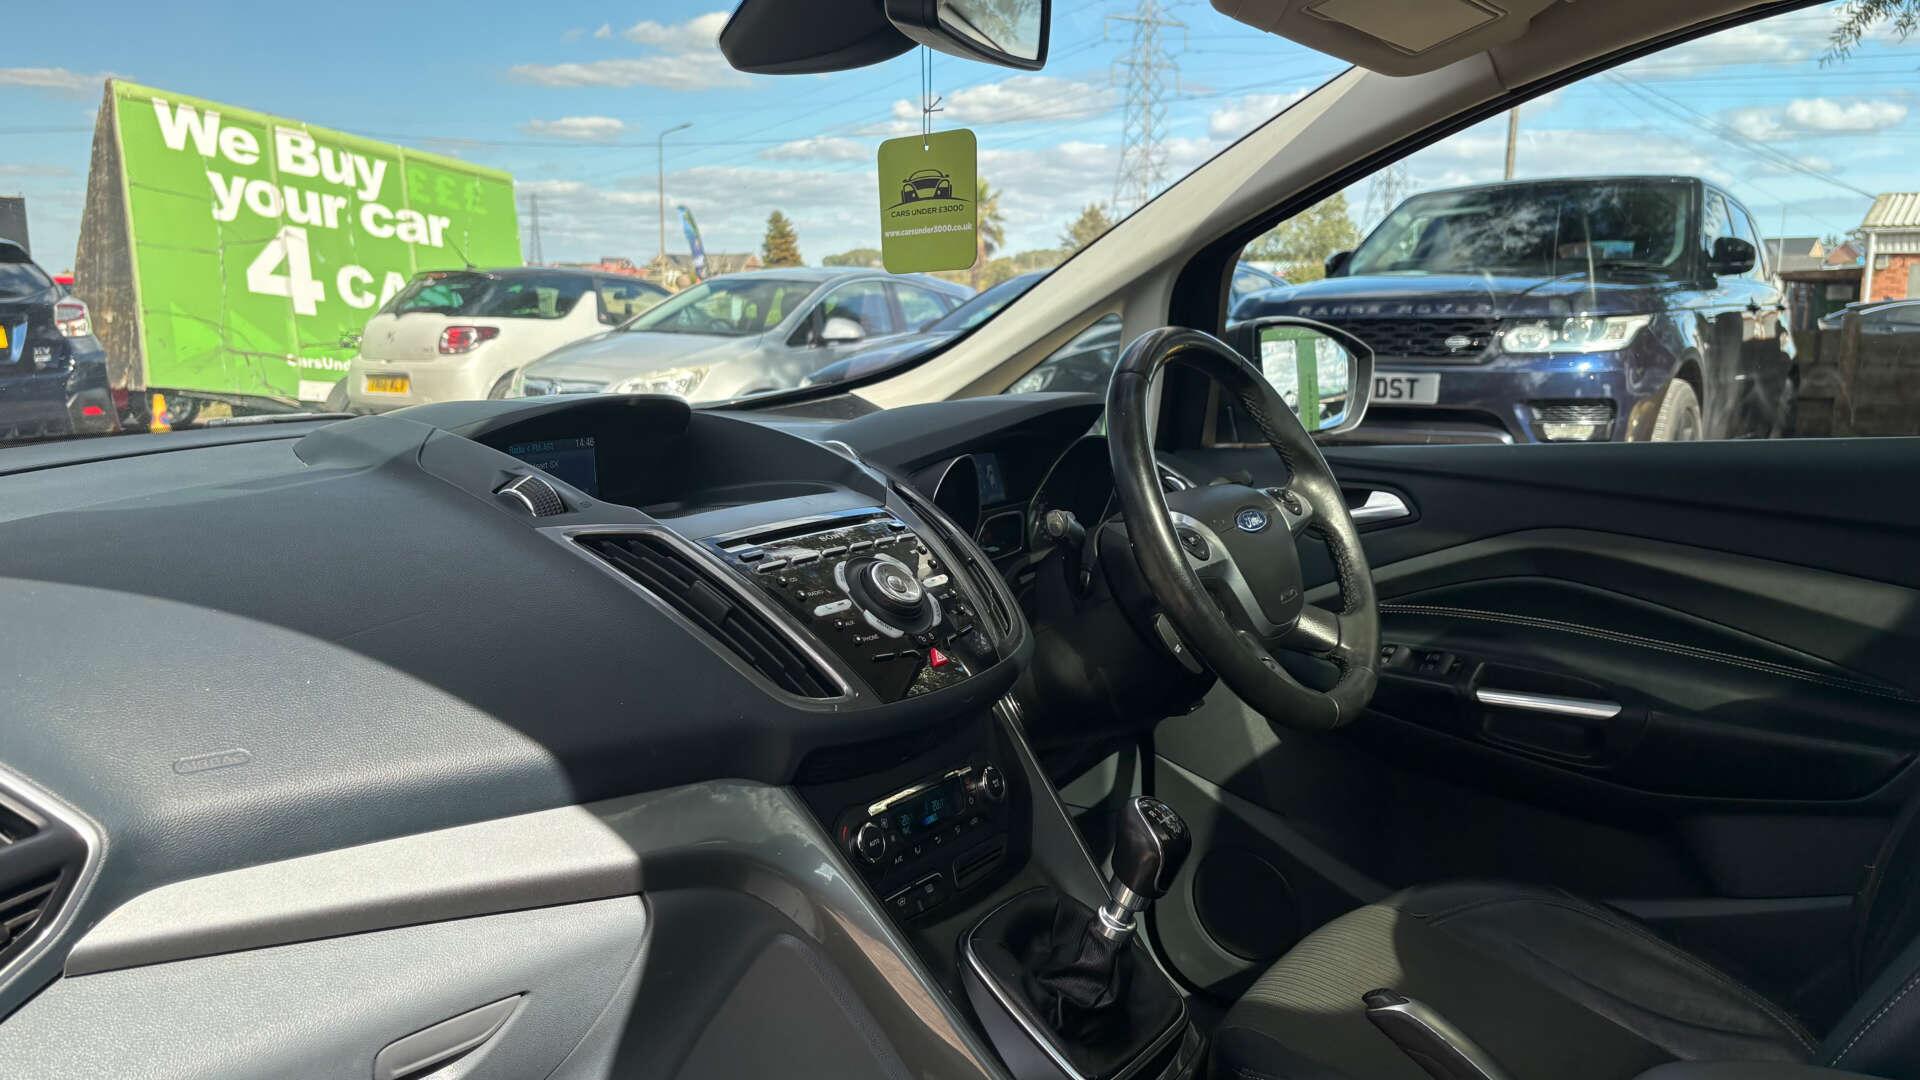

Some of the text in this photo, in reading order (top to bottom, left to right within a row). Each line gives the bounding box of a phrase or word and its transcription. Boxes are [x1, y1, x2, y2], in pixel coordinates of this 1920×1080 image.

[151, 97, 388, 202] We Buy
[206, 170, 451, 249] your car
[911, 207, 937, 216] UNDER
[938, 203, 964, 213] £3000
[885, 222, 972, 237] www.carsunder3000.co.uk
[246, 225, 408, 317] 4 CA
[1297, 303, 1492, 316] RANGE ROVER
[286, 353, 352, 372] CarsUnd
[1374, 377, 1420, 400] DST
